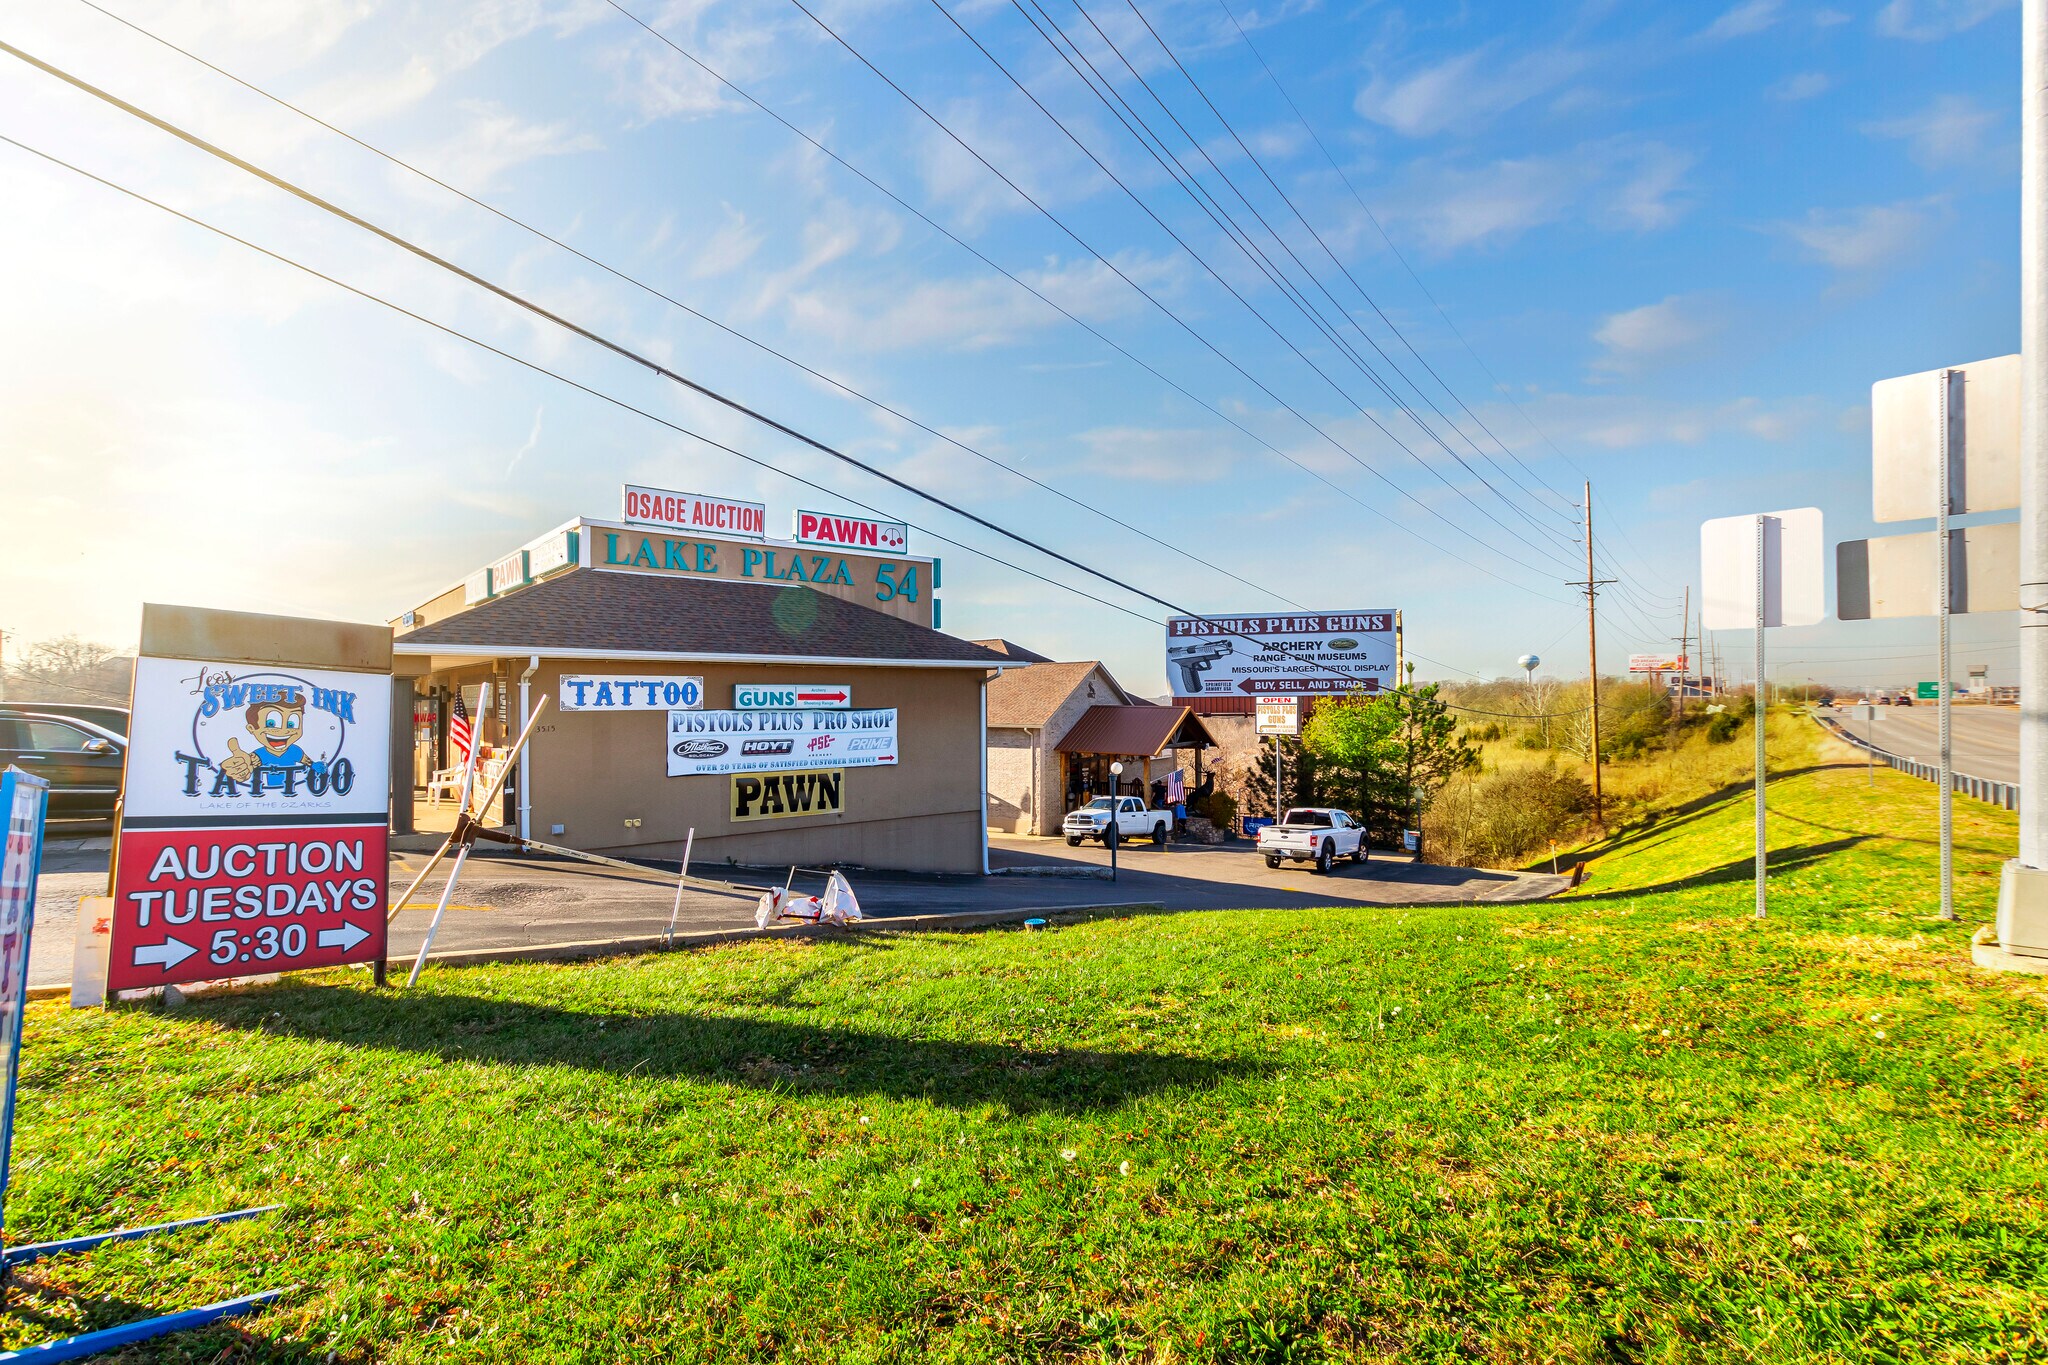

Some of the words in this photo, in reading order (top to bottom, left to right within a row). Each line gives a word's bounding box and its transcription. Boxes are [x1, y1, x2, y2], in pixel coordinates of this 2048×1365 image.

[627, 492, 687, 523] OSAGE
[692, 502, 763, 533] AUCTION
[801, 515, 878, 546] PAWN
[494, 555, 522, 591] PAWN
[605, 533, 718, 573] LAKE
[741, 548, 855, 586] PLAZA
[876, 563, 919, 603] 54
[1176, 619, 1260, 635] PISTOLS
[1266, 617, 1320, 633] PLUS
[1326, 616, 1384, 631] GUNS
[1262, 641, 1323, 651] ARCHERY
[1253, 654, 1286, 662] RANGE
[1294, 653, 1315, 661] GUN
[181, 666, 236, 695] Leo's
[1255, 682, 1276, 691] BUY,
[1279, 681, 1305, 690] SELL,
[1308, 681, 1330, 689] AND
[1333, 681, 1367, 689] TRADE
[200, 683, 303, 718] SWEET
[311, 687, 357, 724] INK
[567, 680, 699, 707] TATTOO
[739, 692, 795, 706] GUNS
[1258, 706, 1280, 714] PISTOLS
[1282, 706, 1296, 714] PLUS
[1268, 715, 1286, 724] GUNS
[672, 713, 753, 732] PISTOLS
[759, 712, 803, 731] PLUS
[813, 712, 848, 730] PRO
[851, 711, 894, 729] SHOP
[744, 741, 791, 751] HOYT
[808, 735, 835, 751] PSE
[849, 737, 890, 749] PRIME
[175, 750, 355, 797] TATTOO
[770, 760, 808, 768] SATISFIED
[810, 758, 846, 766] CUSTOMER
[199, 801, 232, 809] LAKE
[254, 801, 277, 809] THE
[281, 801, 332, 809] OZARKS
[735, 773, 841, 816] PAWN
[149, 840, 363, 882] AUCTION
[129, 878, 377, 927] TUESDAYS
[210, 923, 307, 965] 5:30
